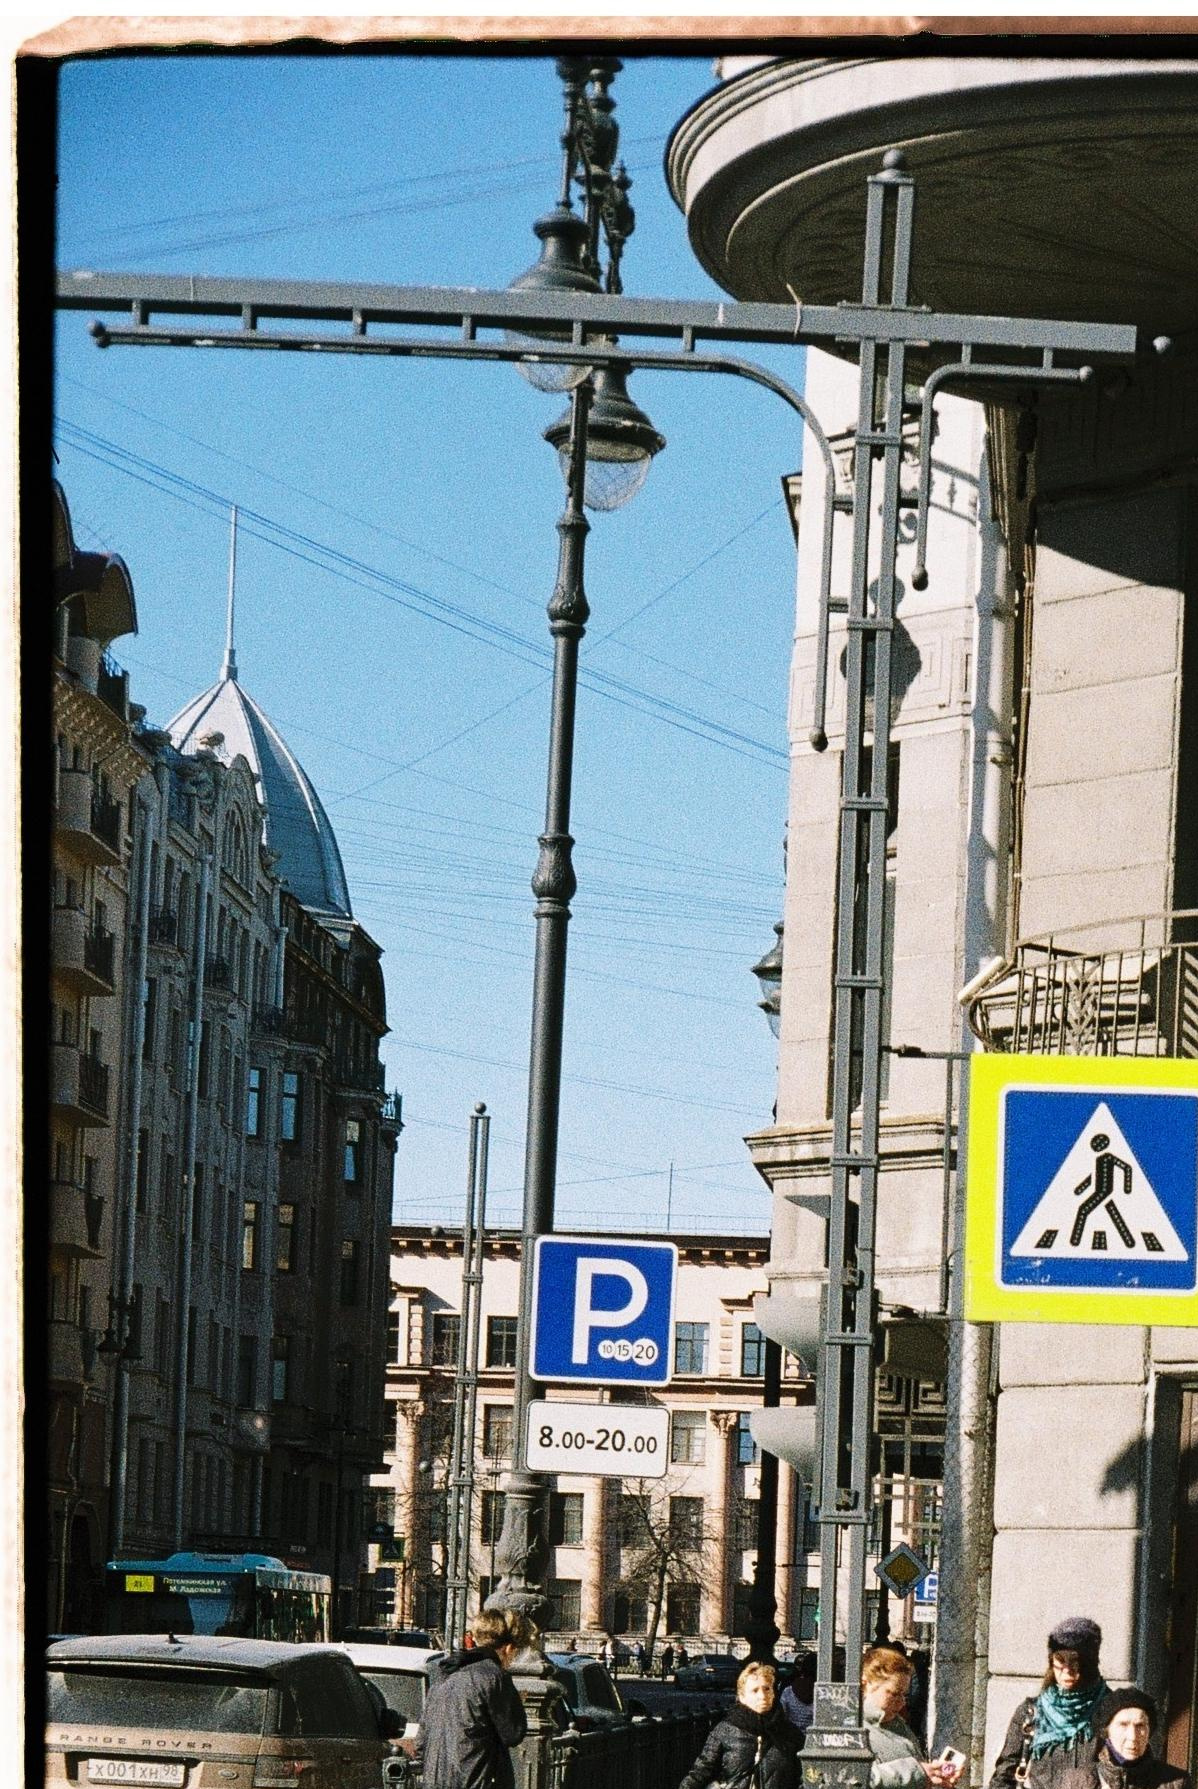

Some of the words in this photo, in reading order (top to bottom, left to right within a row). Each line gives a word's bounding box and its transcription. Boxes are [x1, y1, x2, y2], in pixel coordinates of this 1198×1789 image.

[571, 1257, 649, 1365] P
[602, 1343, 613, 1355] 10
[617, 1344, 630, 1357] 15
[635, 1344, 656, 1360] 20
[538, 1424, 658, 1455] 8.00-20.00
[59, 1734, 127, 1745] RANGE
[141, 1739, 213, 1750] ROVER
[162, 1765, 178, 1778] 98
